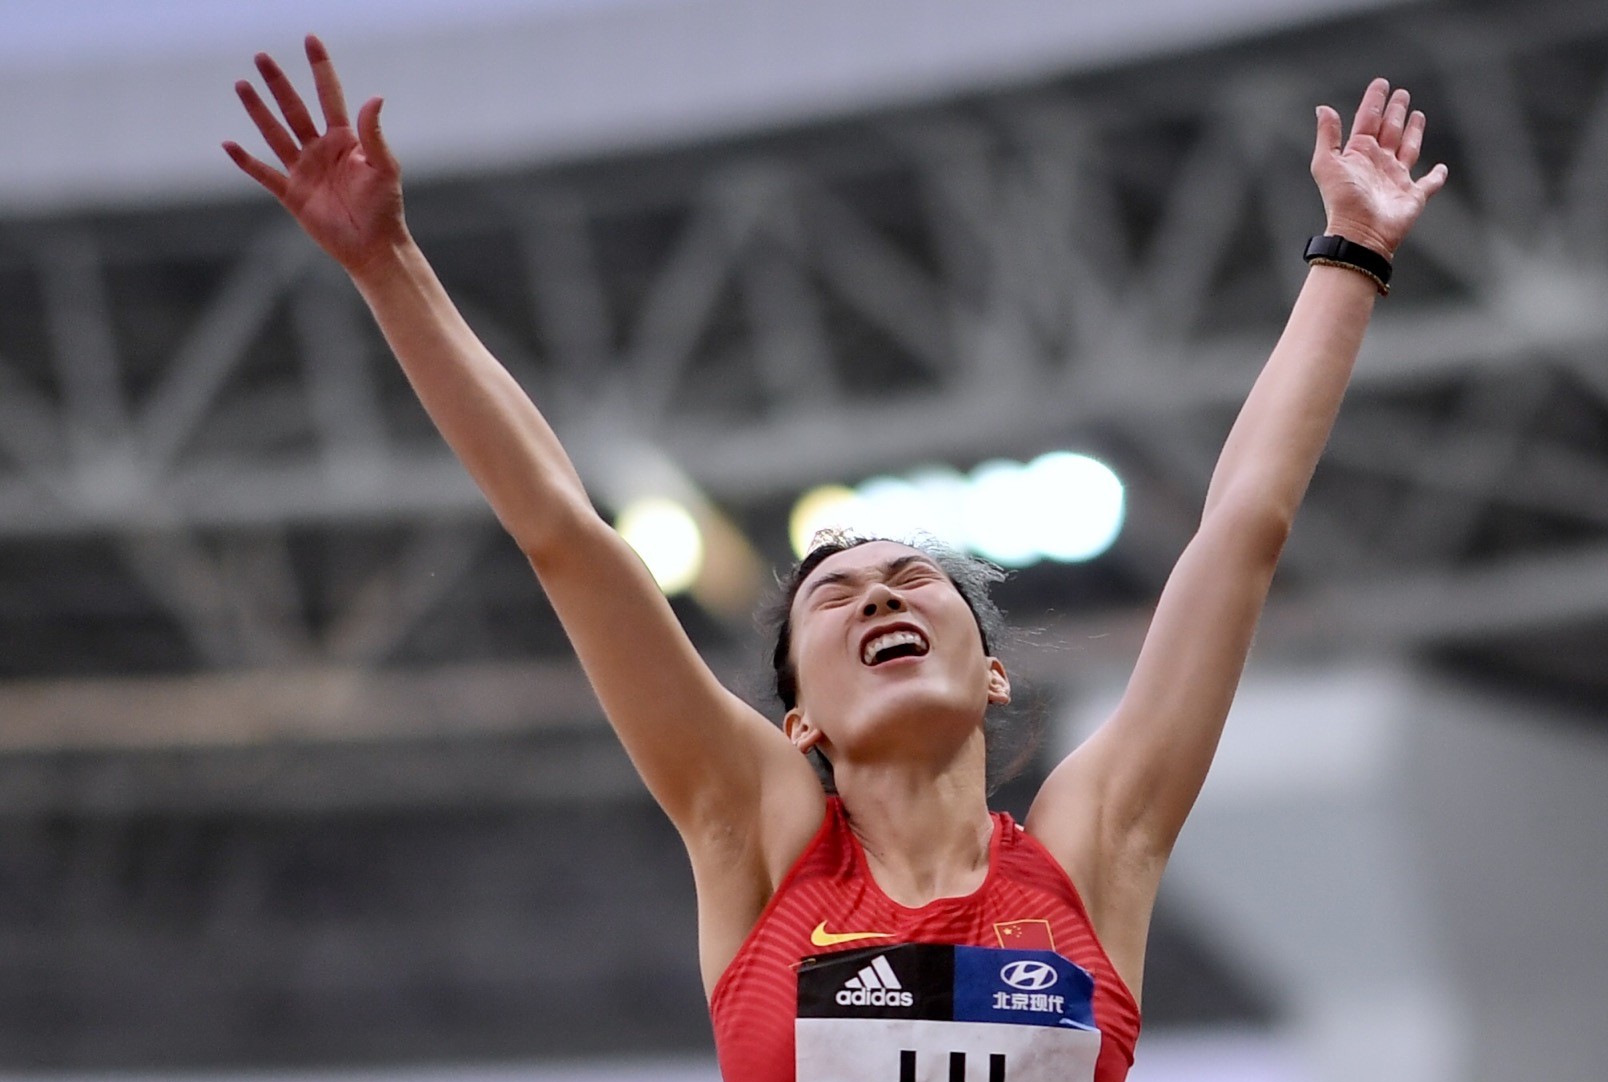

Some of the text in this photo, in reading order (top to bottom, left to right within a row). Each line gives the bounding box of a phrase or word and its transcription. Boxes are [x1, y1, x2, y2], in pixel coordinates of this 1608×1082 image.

[836, 988, 913, 1007] adidas
[992, 991, 1064, 1013] 北京现代
